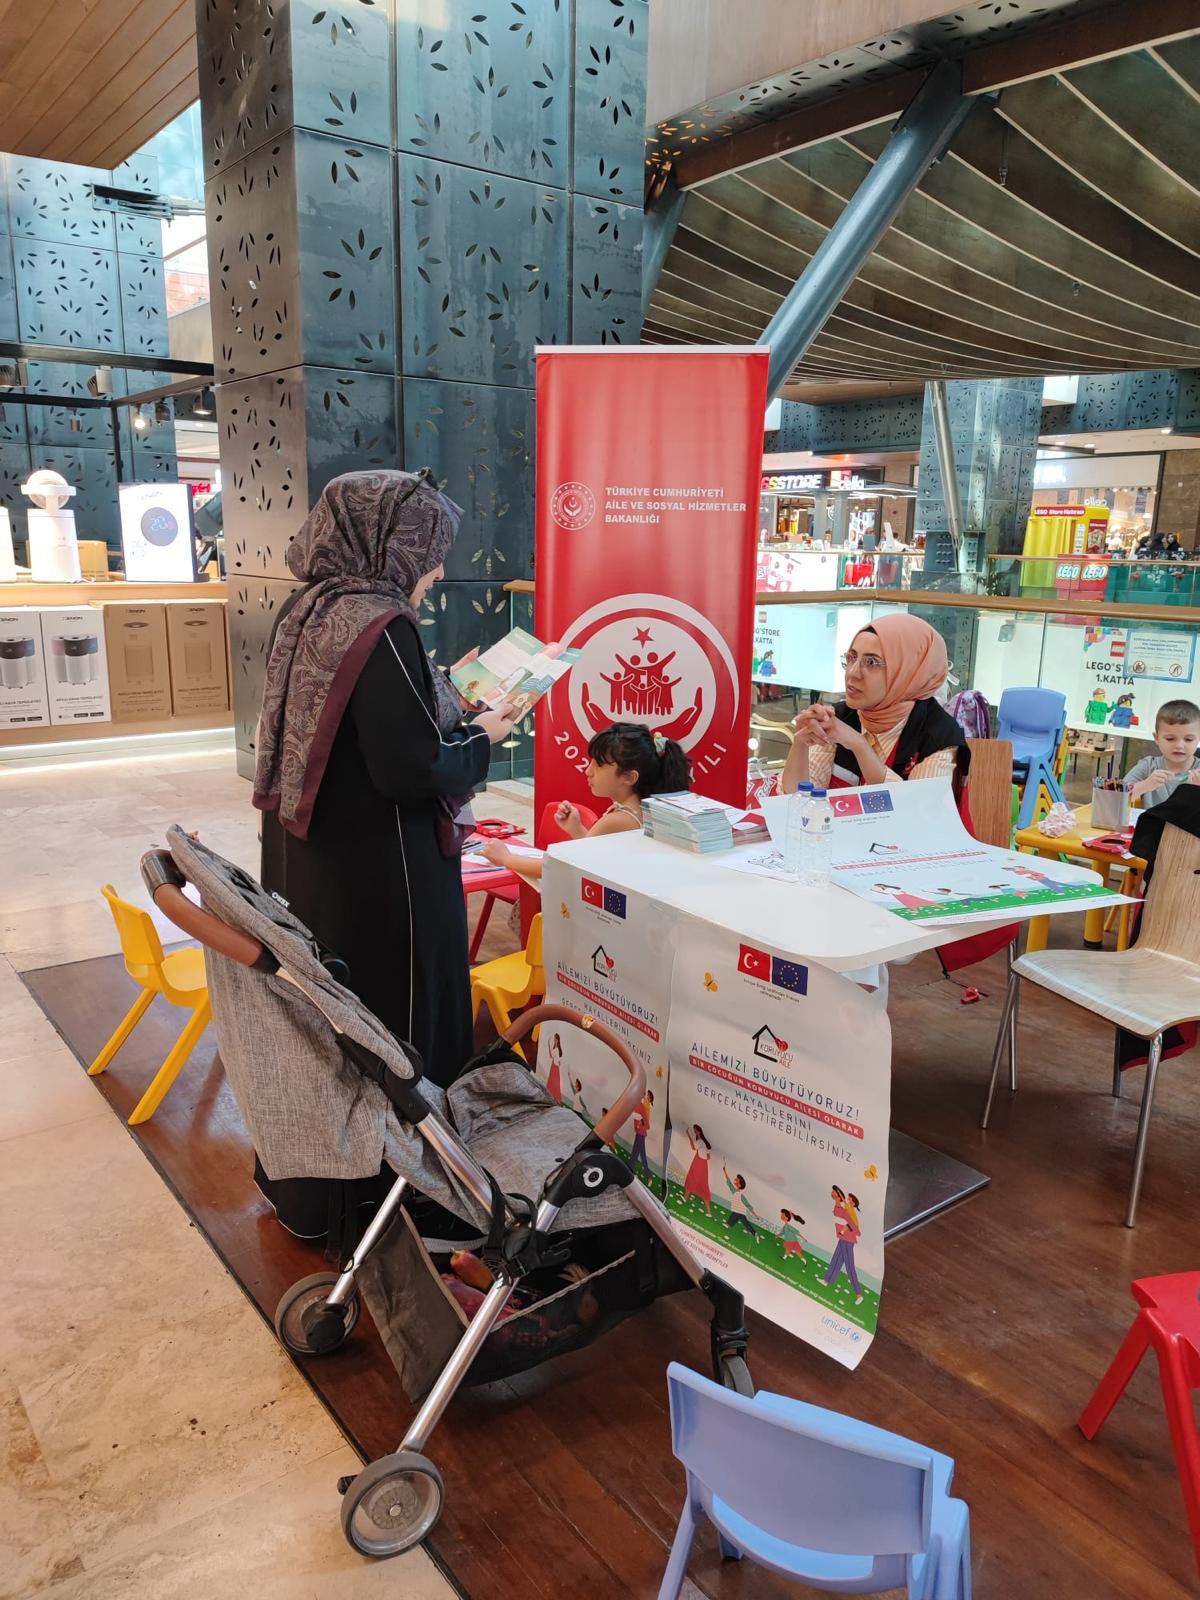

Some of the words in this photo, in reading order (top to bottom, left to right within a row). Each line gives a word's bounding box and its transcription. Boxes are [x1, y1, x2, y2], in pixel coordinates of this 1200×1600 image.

[605, 487, 650, 497] TÜRKİYE
[653, 487, 724, 498] CUMHURİYETİ
[605, 500, 628, 510] AİLE
[630, 501, 644, 510] VE
[646, 502, 685, 511] SOSYAL
[688, 501, 747, 512] HİZMETLER
[605, 514, 660, 524] BAKANLIĞI
[1056, 564, 1080, 579] LEGO
[1081, 564, 1107, 580] LEGO
[691, 1041, 748, 1074] AİLEMİZİ
[753, 1066, 861, 1121] BÜYÜTÜYORUZ!
[735, 1089, 812, 1131] HAYALLERİNİ
[747, 1078, 792, 1106] KORUYUCU
[824, 1113, 861, 1137] OLARAK
[821, 1315, 852, 1338] unicef
